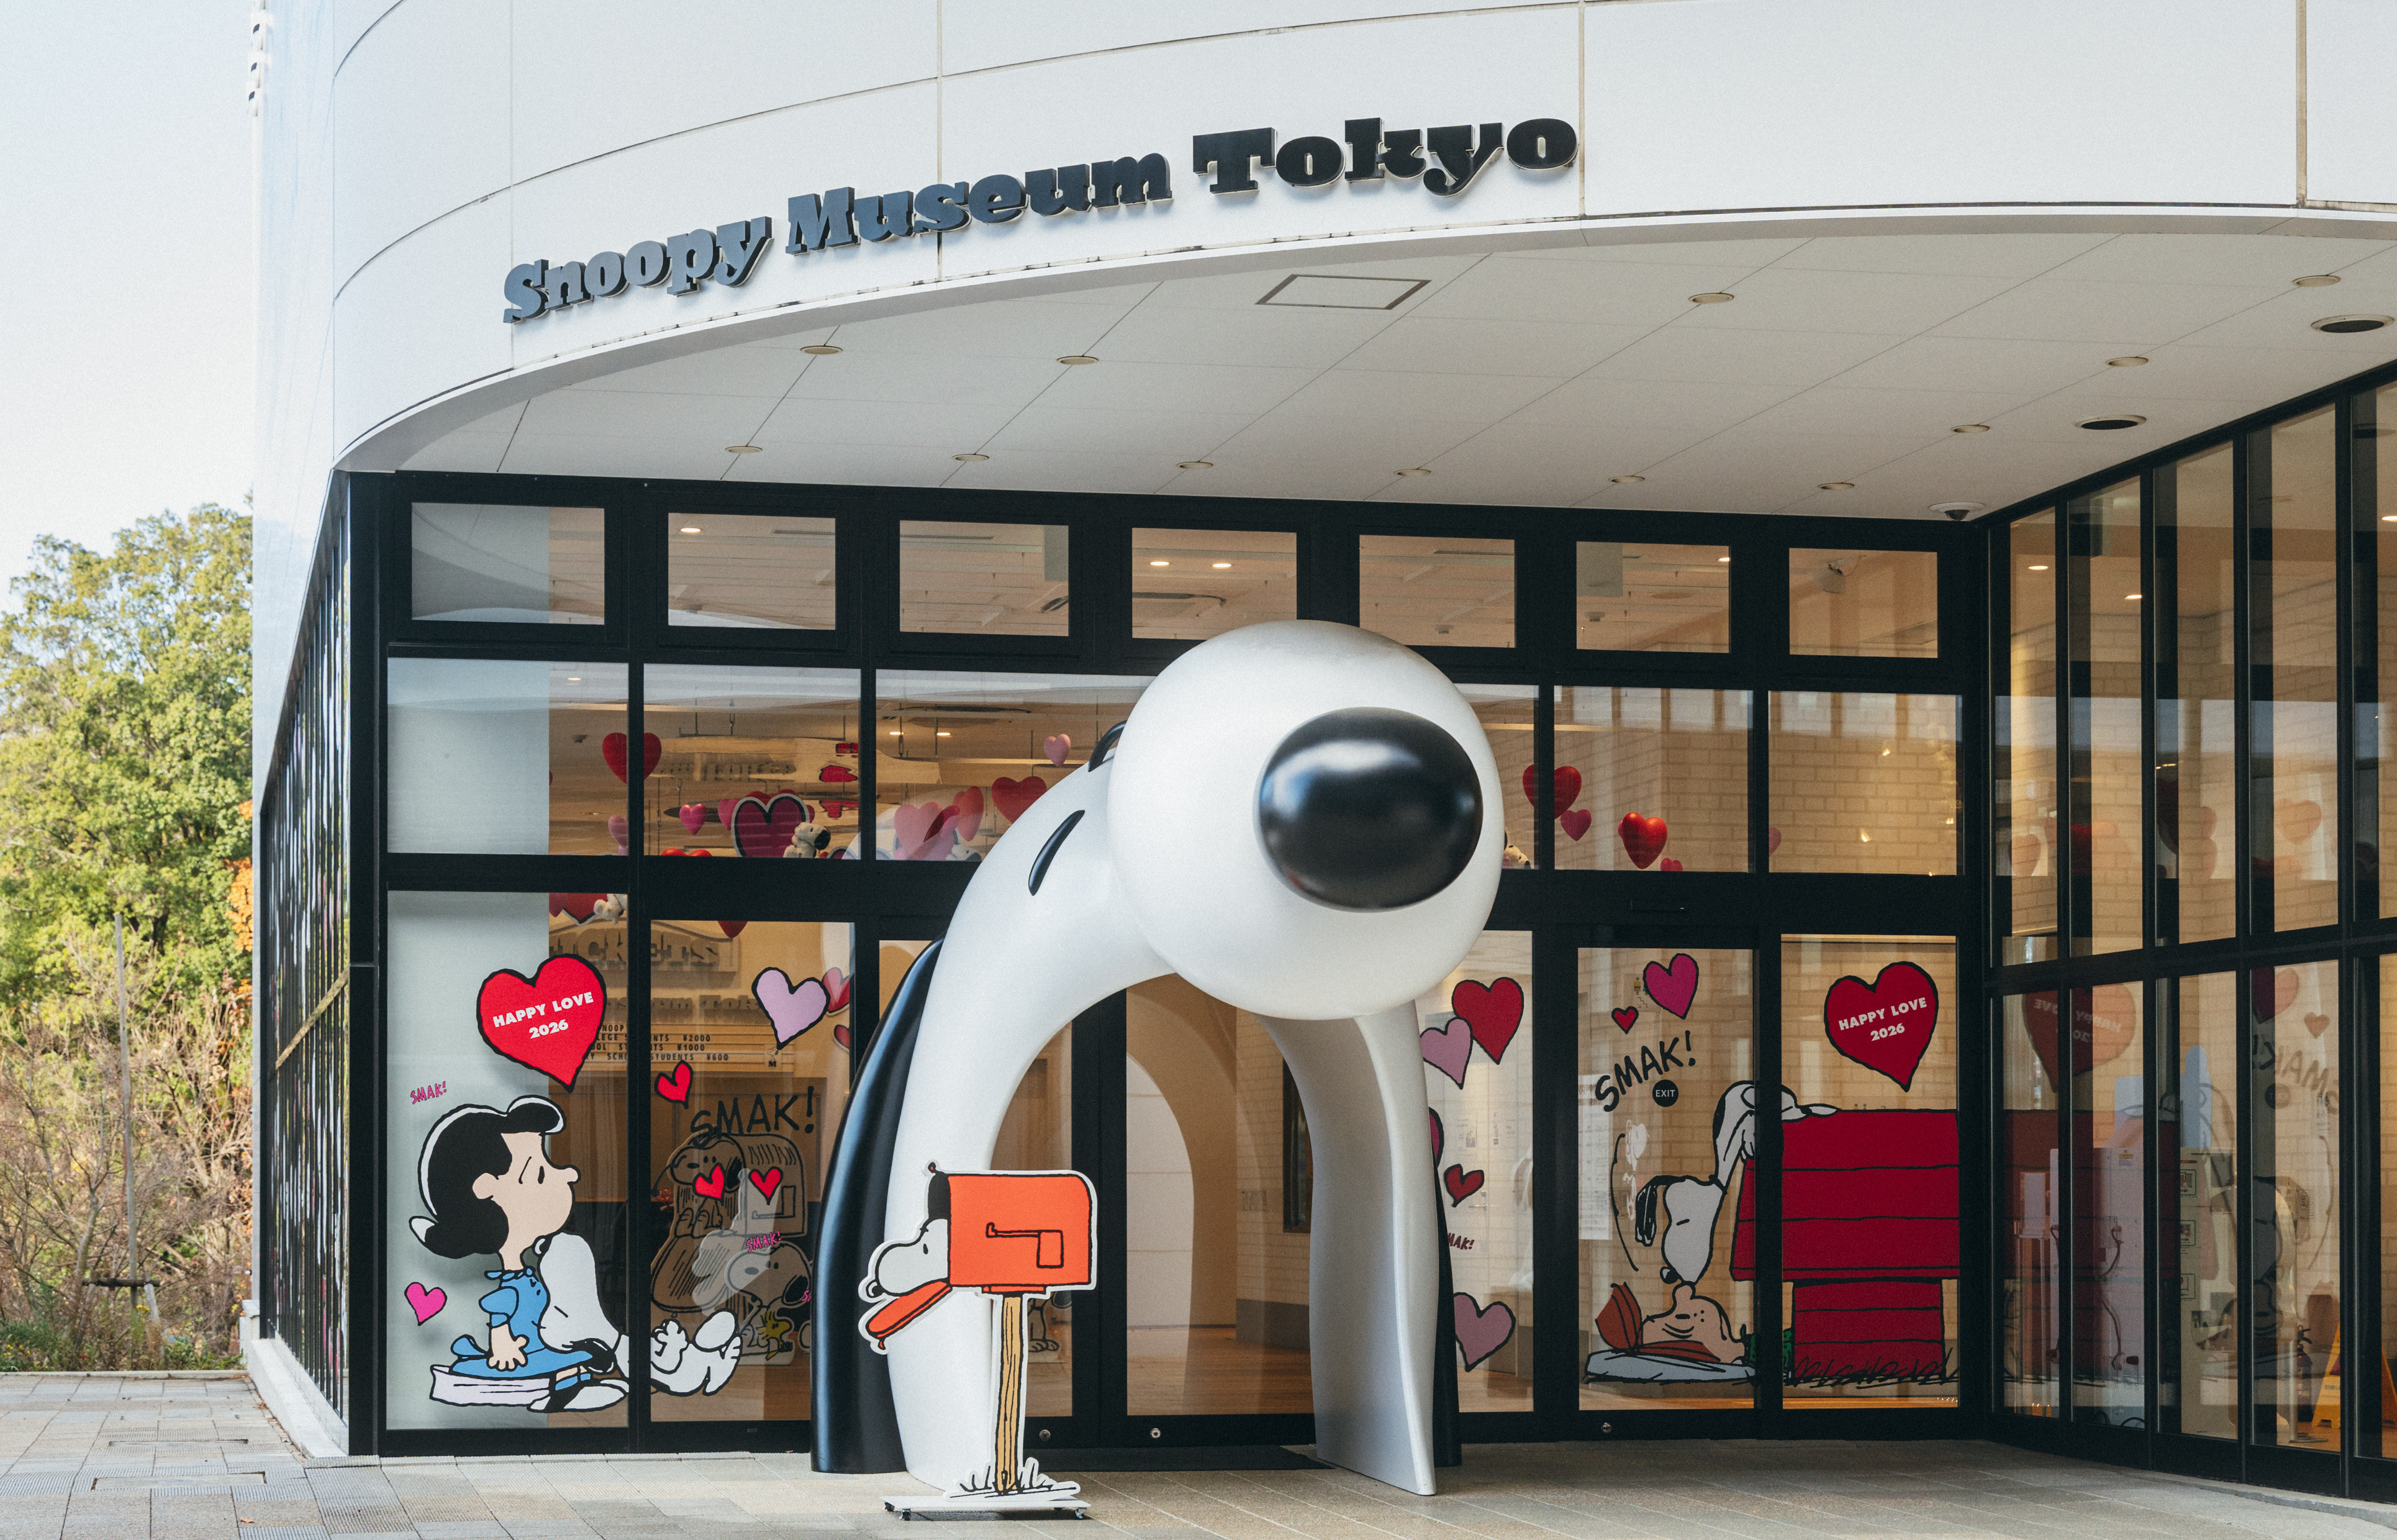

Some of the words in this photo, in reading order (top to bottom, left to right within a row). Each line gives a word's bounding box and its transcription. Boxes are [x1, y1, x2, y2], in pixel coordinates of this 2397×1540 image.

[503, 216, 773, 324] Snoopy
[786, 153, 1172, 255] Museum
[1193, 117, 1578, 197] Tokyo
[493, 1003, 546, 1028] HAPPY
[552, 992, 594, 1012] LOVE
[1839, 1008, 1885, 1031] HAPPY
[1891, 997, 1927, 1016] LOVE
[529, 1019, 569, 1039] 2026
[1870, 1023, 1905, 1041] 2026
[1595, 1030, 1696, 1112] SMAK!
[410, 1081, 447, 1105] SMAK!
[691, 1086, 814, 1149] SMAK!
[746, 1230, 781, 1252] SMAK!
[1448, 1233, 1475, 1250] MAK!
